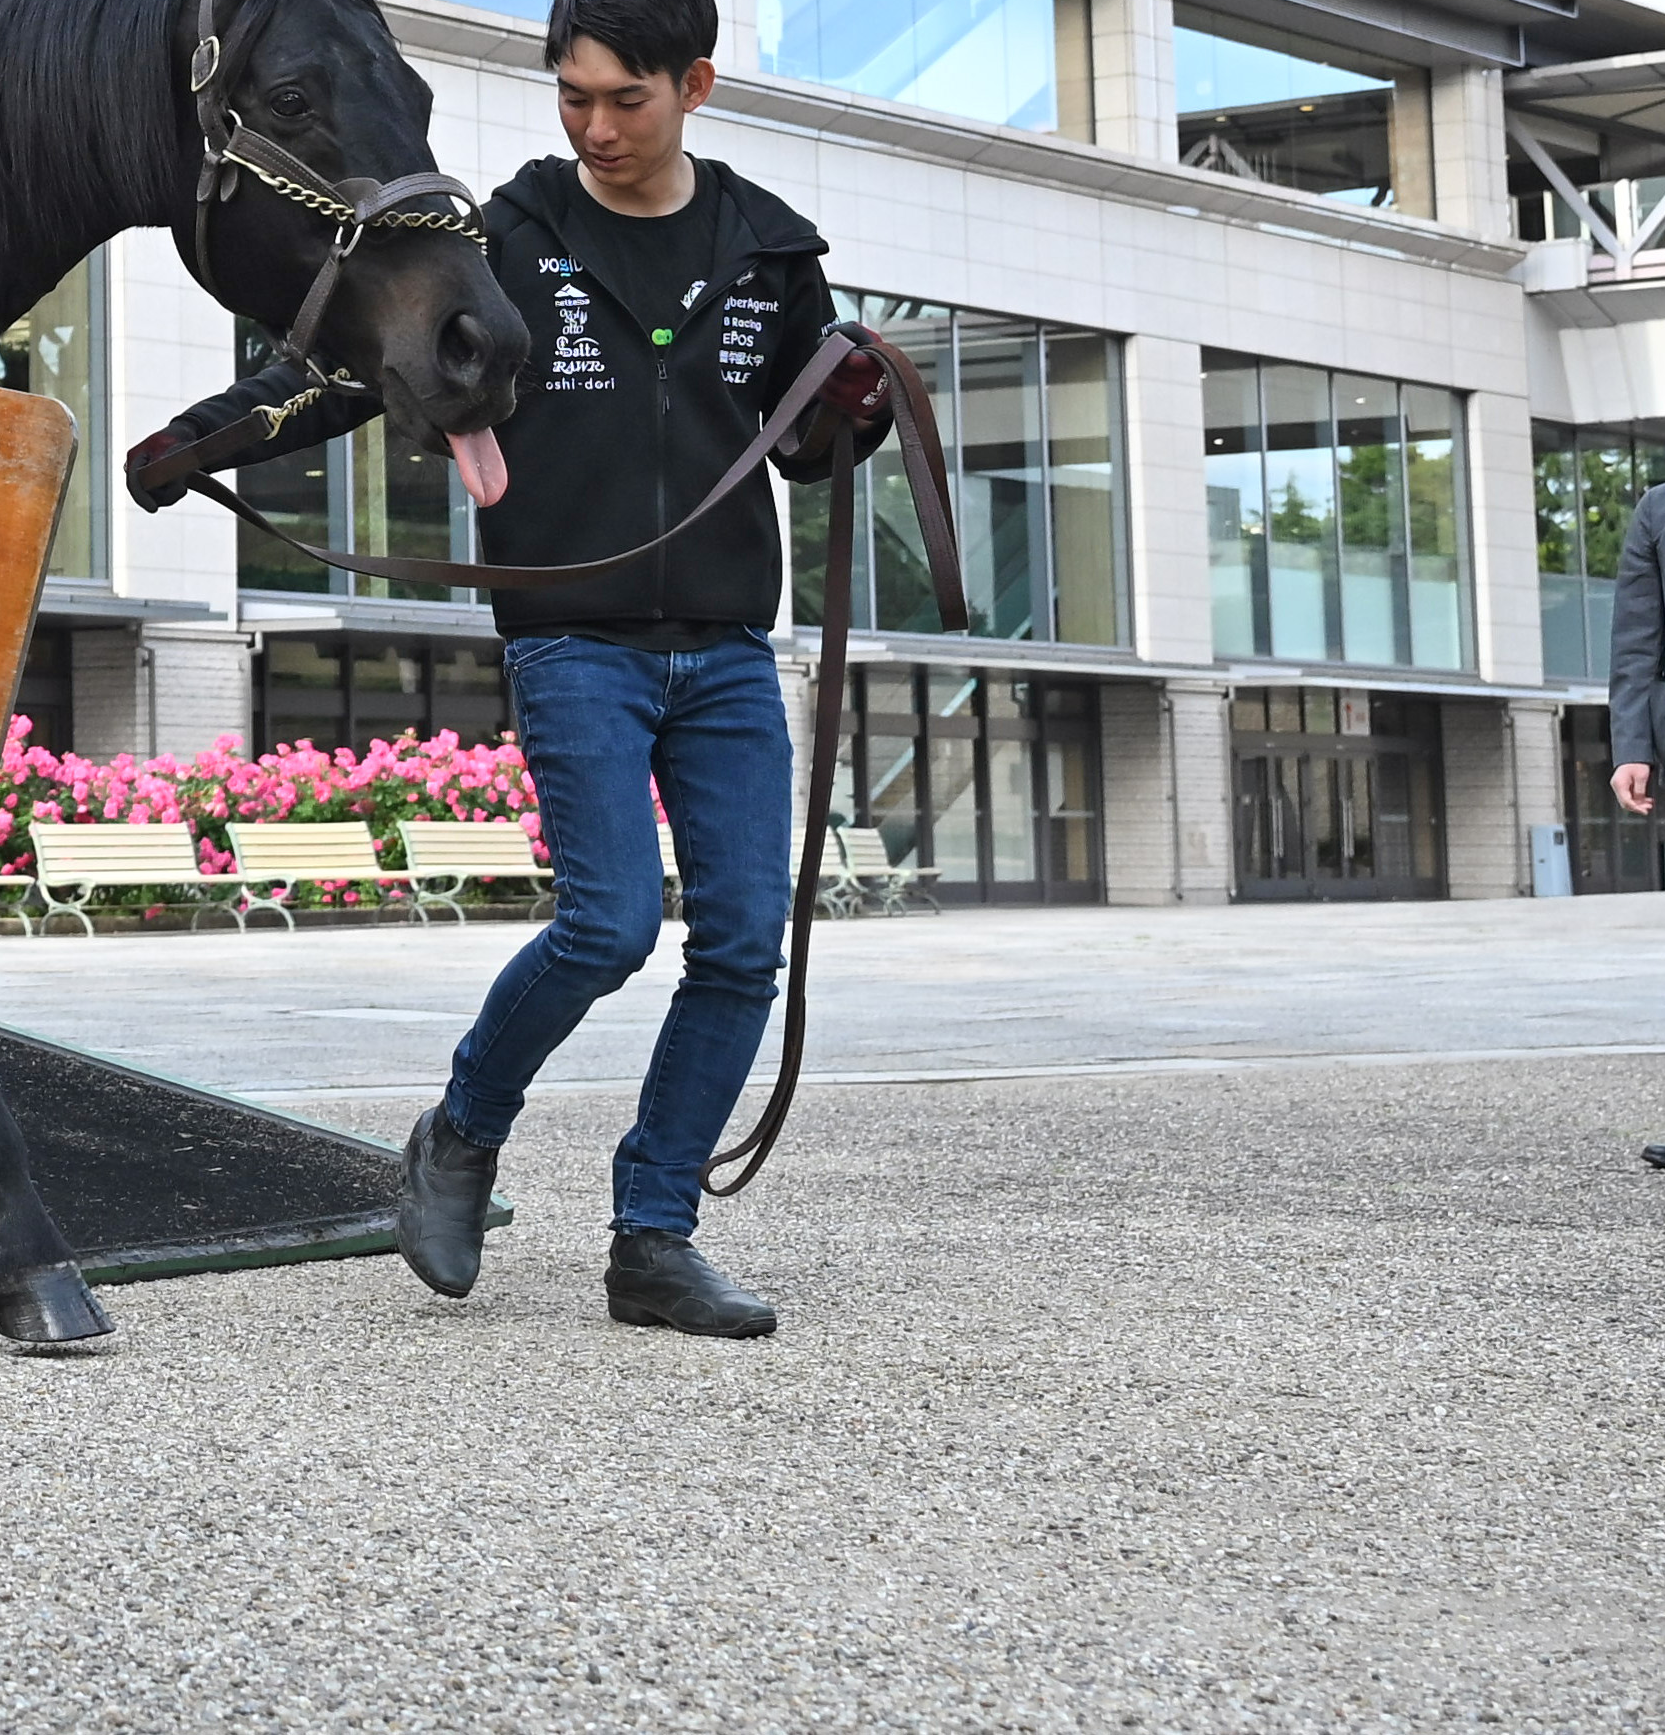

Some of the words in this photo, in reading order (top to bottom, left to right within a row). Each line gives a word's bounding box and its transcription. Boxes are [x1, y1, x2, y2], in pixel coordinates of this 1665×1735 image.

[732, 317, 763, 332] Racing
[723, 330, 755, 347] EPOS
[545, 377, 615, 391] oshi-dori
